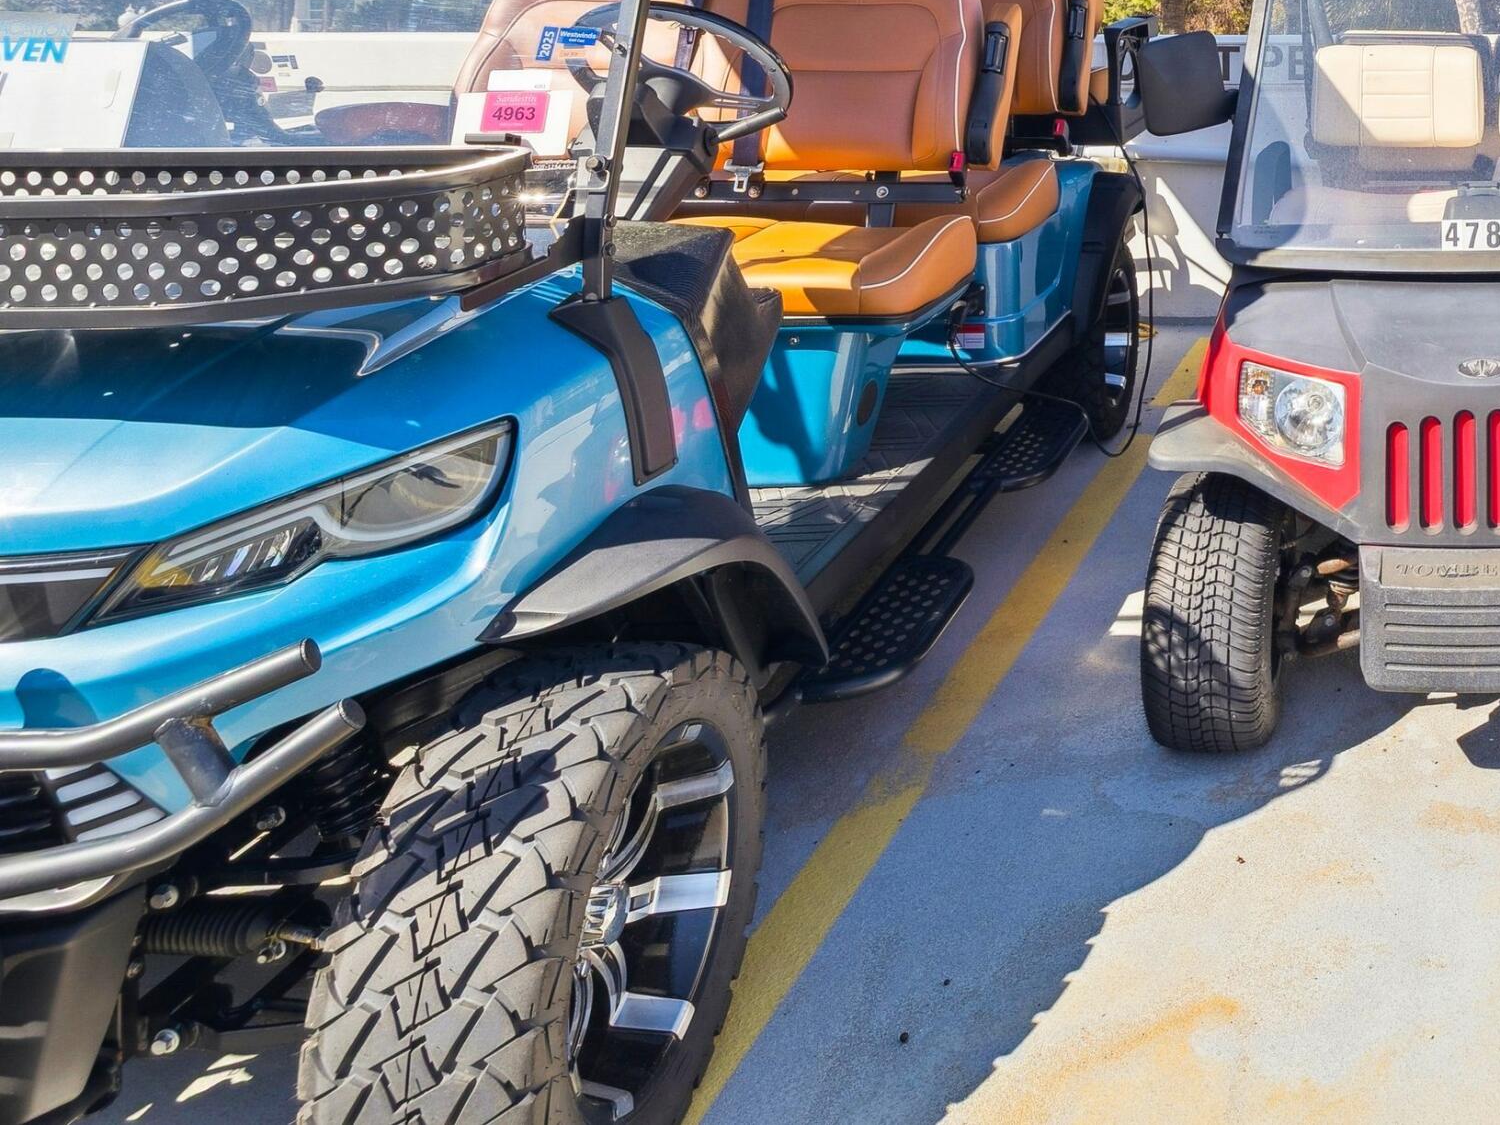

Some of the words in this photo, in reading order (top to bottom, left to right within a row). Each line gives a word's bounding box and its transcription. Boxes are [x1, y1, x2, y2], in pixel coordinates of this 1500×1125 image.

[560, 30, 597, 40] Westwinds
[538, 31, 555, 58] 2025
[492, 106, 536, 121] 4963
